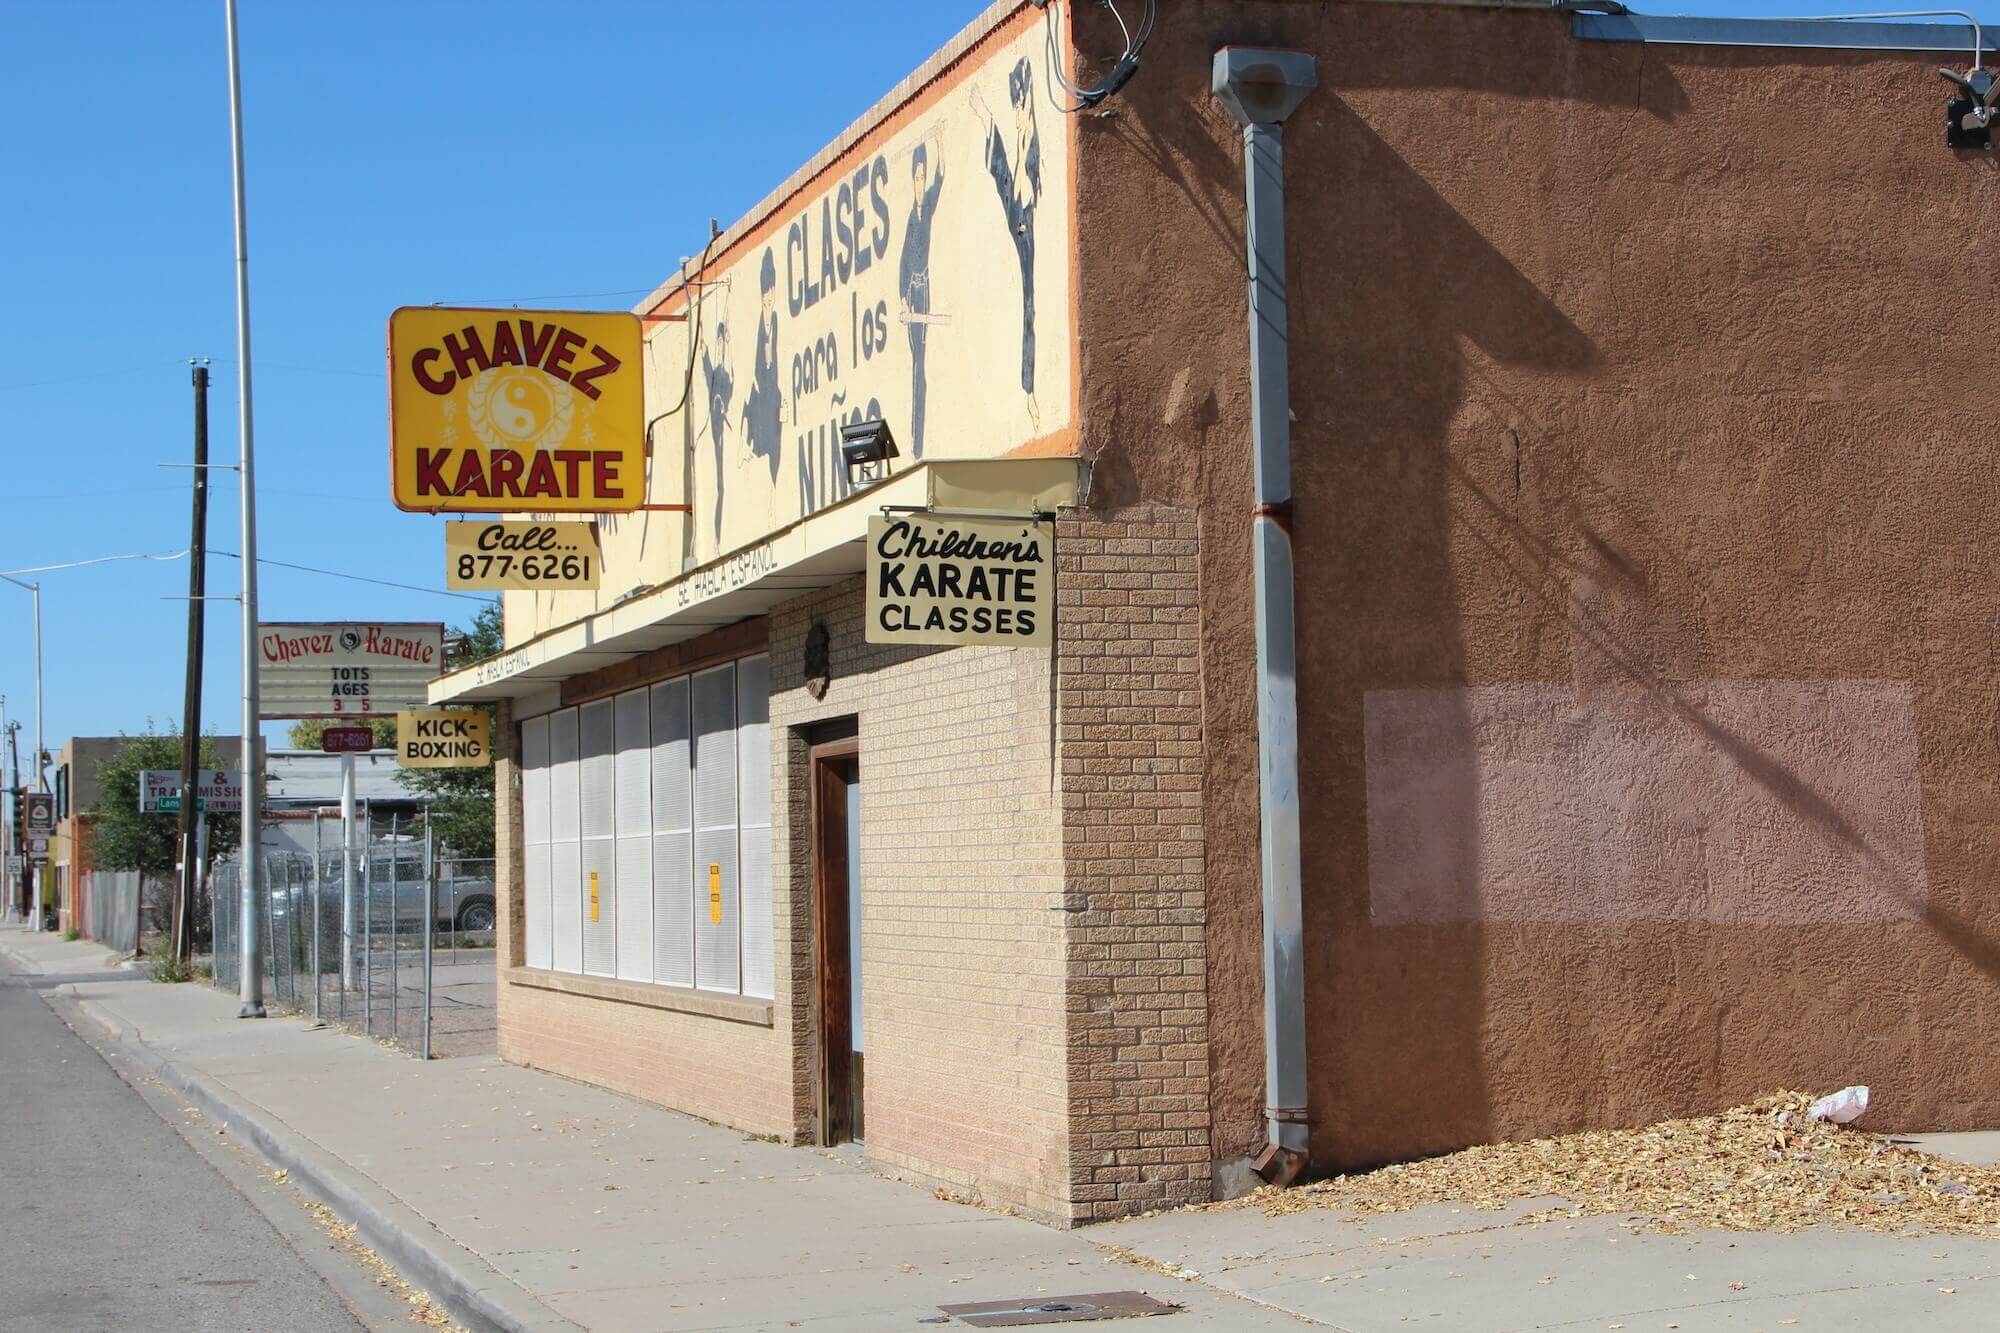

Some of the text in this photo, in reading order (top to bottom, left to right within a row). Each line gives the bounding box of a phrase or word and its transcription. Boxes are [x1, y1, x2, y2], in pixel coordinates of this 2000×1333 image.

[787, 155, 890, 318] CLASES
[412, 319, 621, 401] CHAVEZ
[792, 291, 888, 427] para los
[416, 447, 624, 498] KARATE
[478, 525, 577, 551] Call...
[877, 521, 1044, 563] Children's
[879, 562, 1036, 603] KARATE
[879, 604, 1036, 635] CLASSES
[262, 626, 434, 664] Chavez Karate
[331, 667, 369, 680] TOTS
[331, 683, 369, 696] AGES
[333, 699, 370, 711] 3 5
[327, 733, 369, 747] 877-6261
[417, 719, 477, 737] KICK-
[407, 742, 480, 758] BOXING
[214, 772, 228, 785] &
